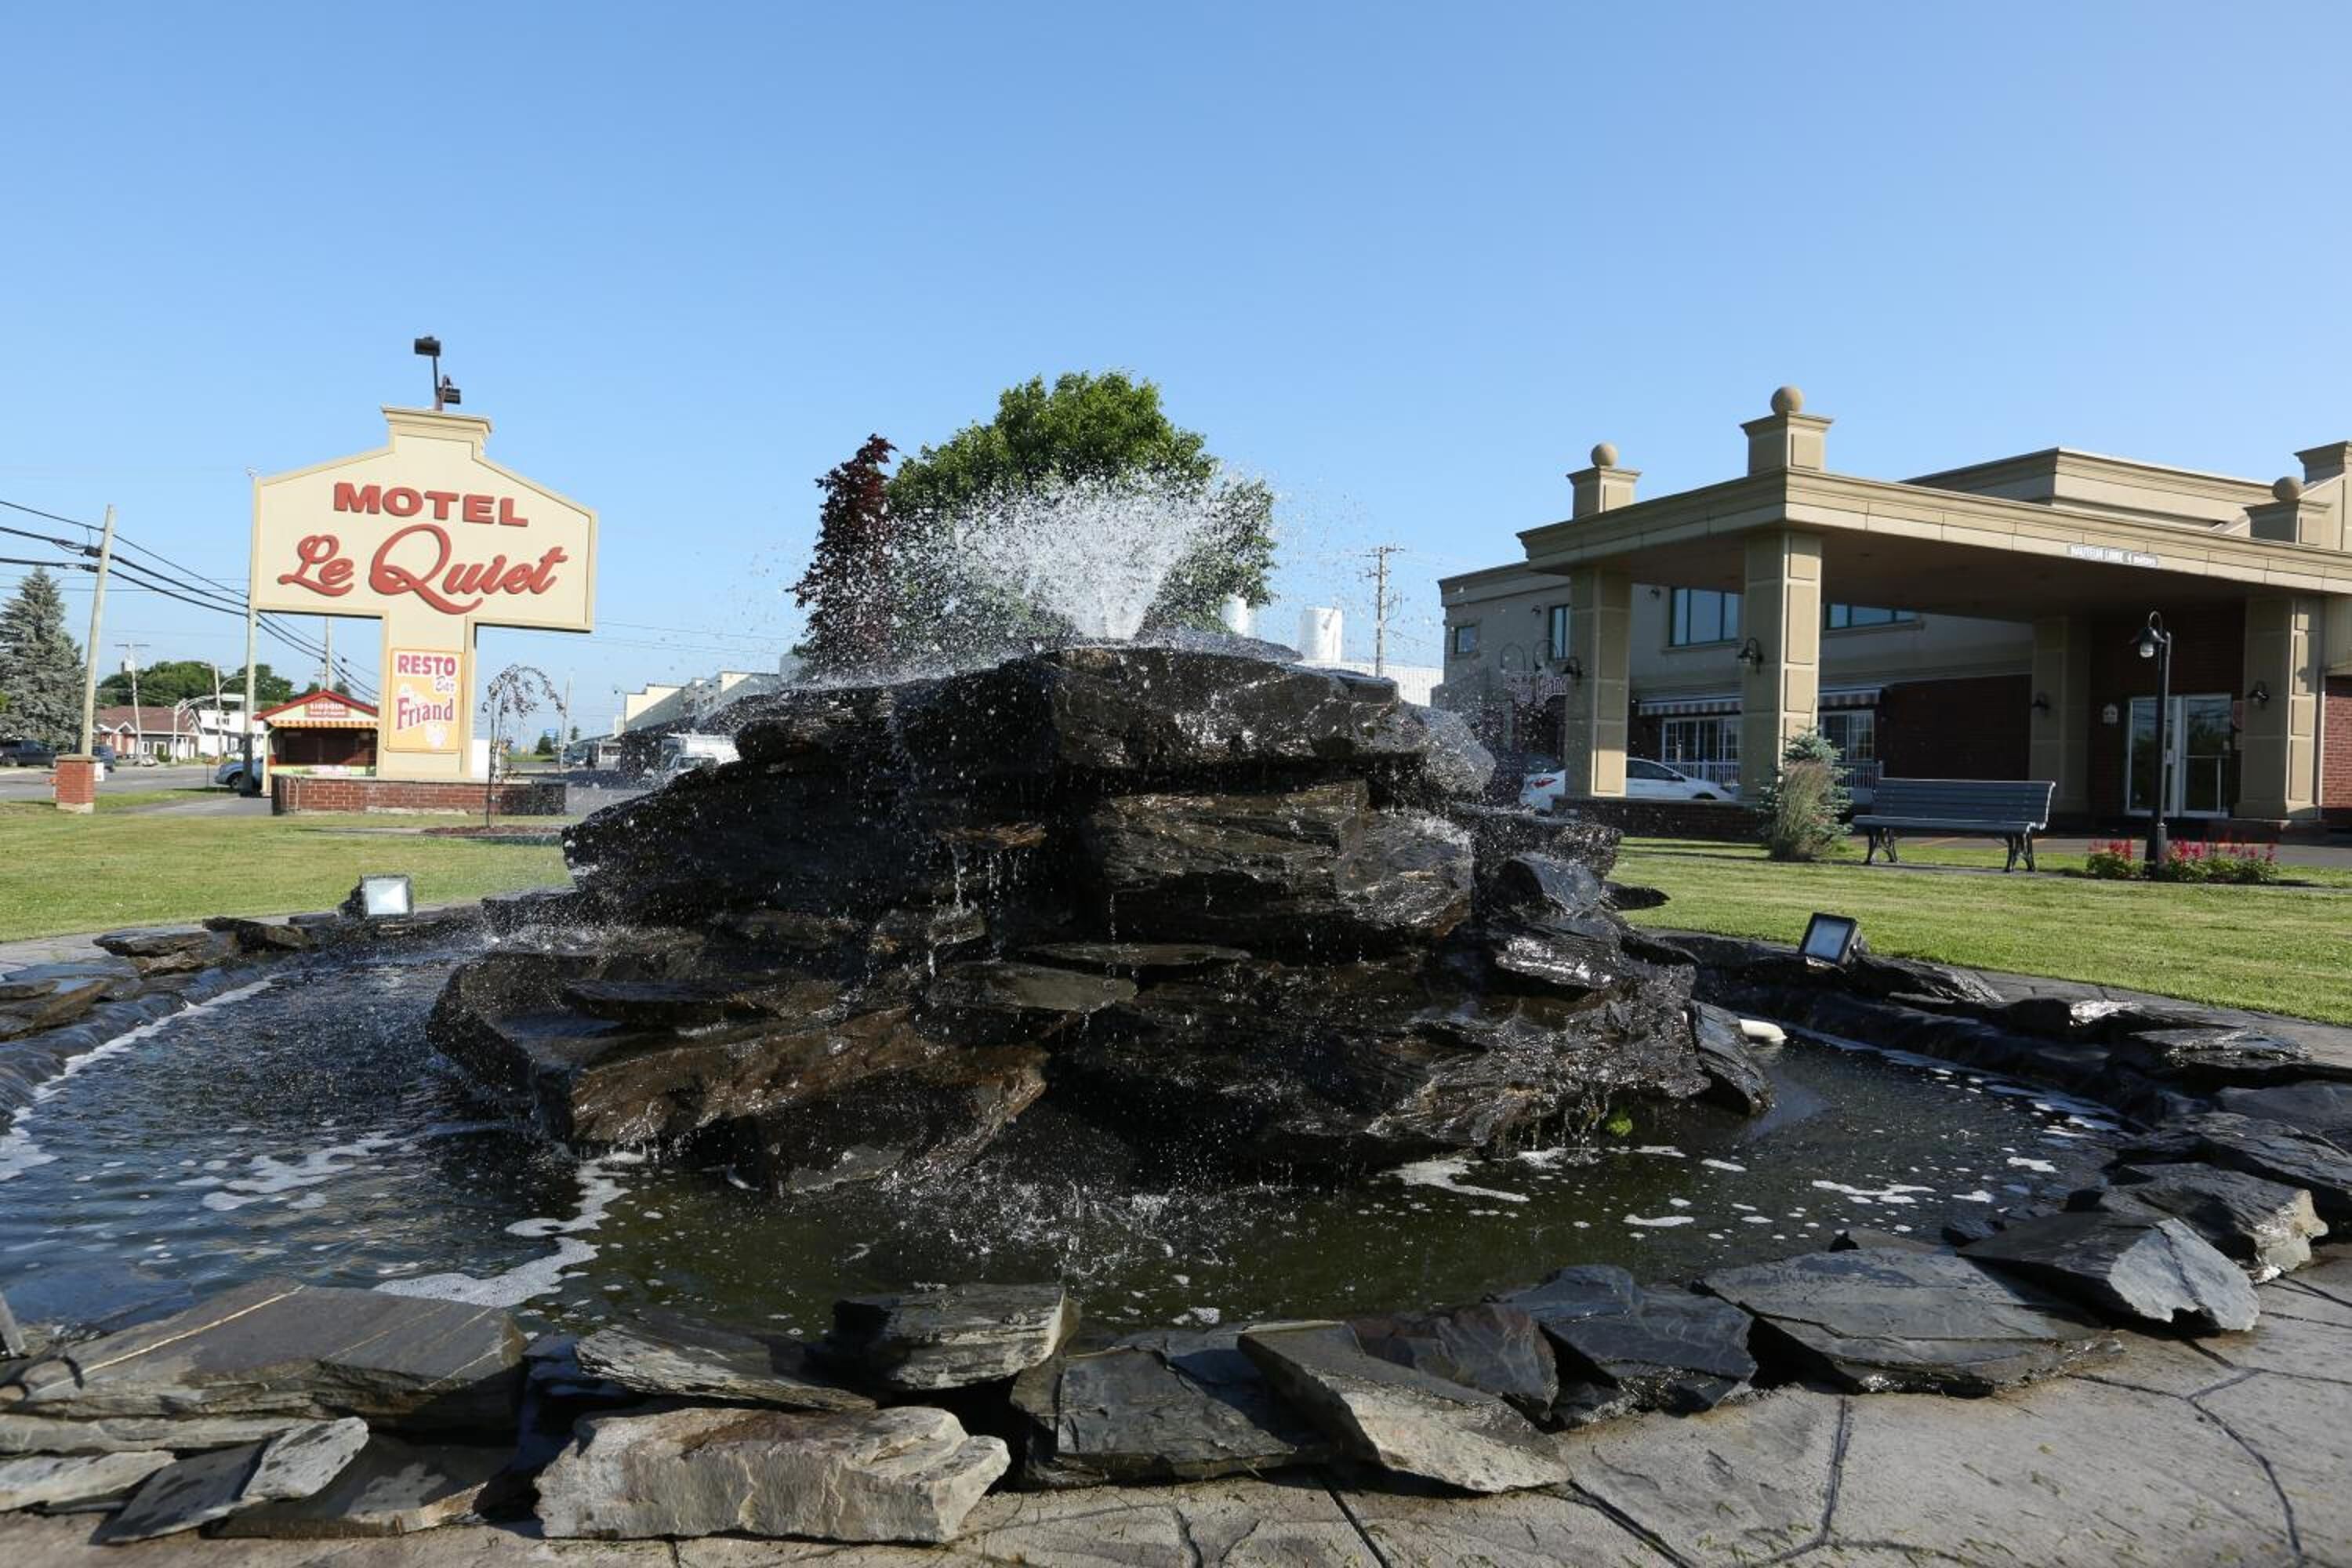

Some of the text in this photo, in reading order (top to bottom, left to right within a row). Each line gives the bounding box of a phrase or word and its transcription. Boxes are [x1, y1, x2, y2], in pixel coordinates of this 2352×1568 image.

[333, 482, 528, 527] MOTEL
[277, 523, 568, 615] Le Quiet
[397, 654, 456, 677] RESTO
[396, 697, 454, 731] Friand
